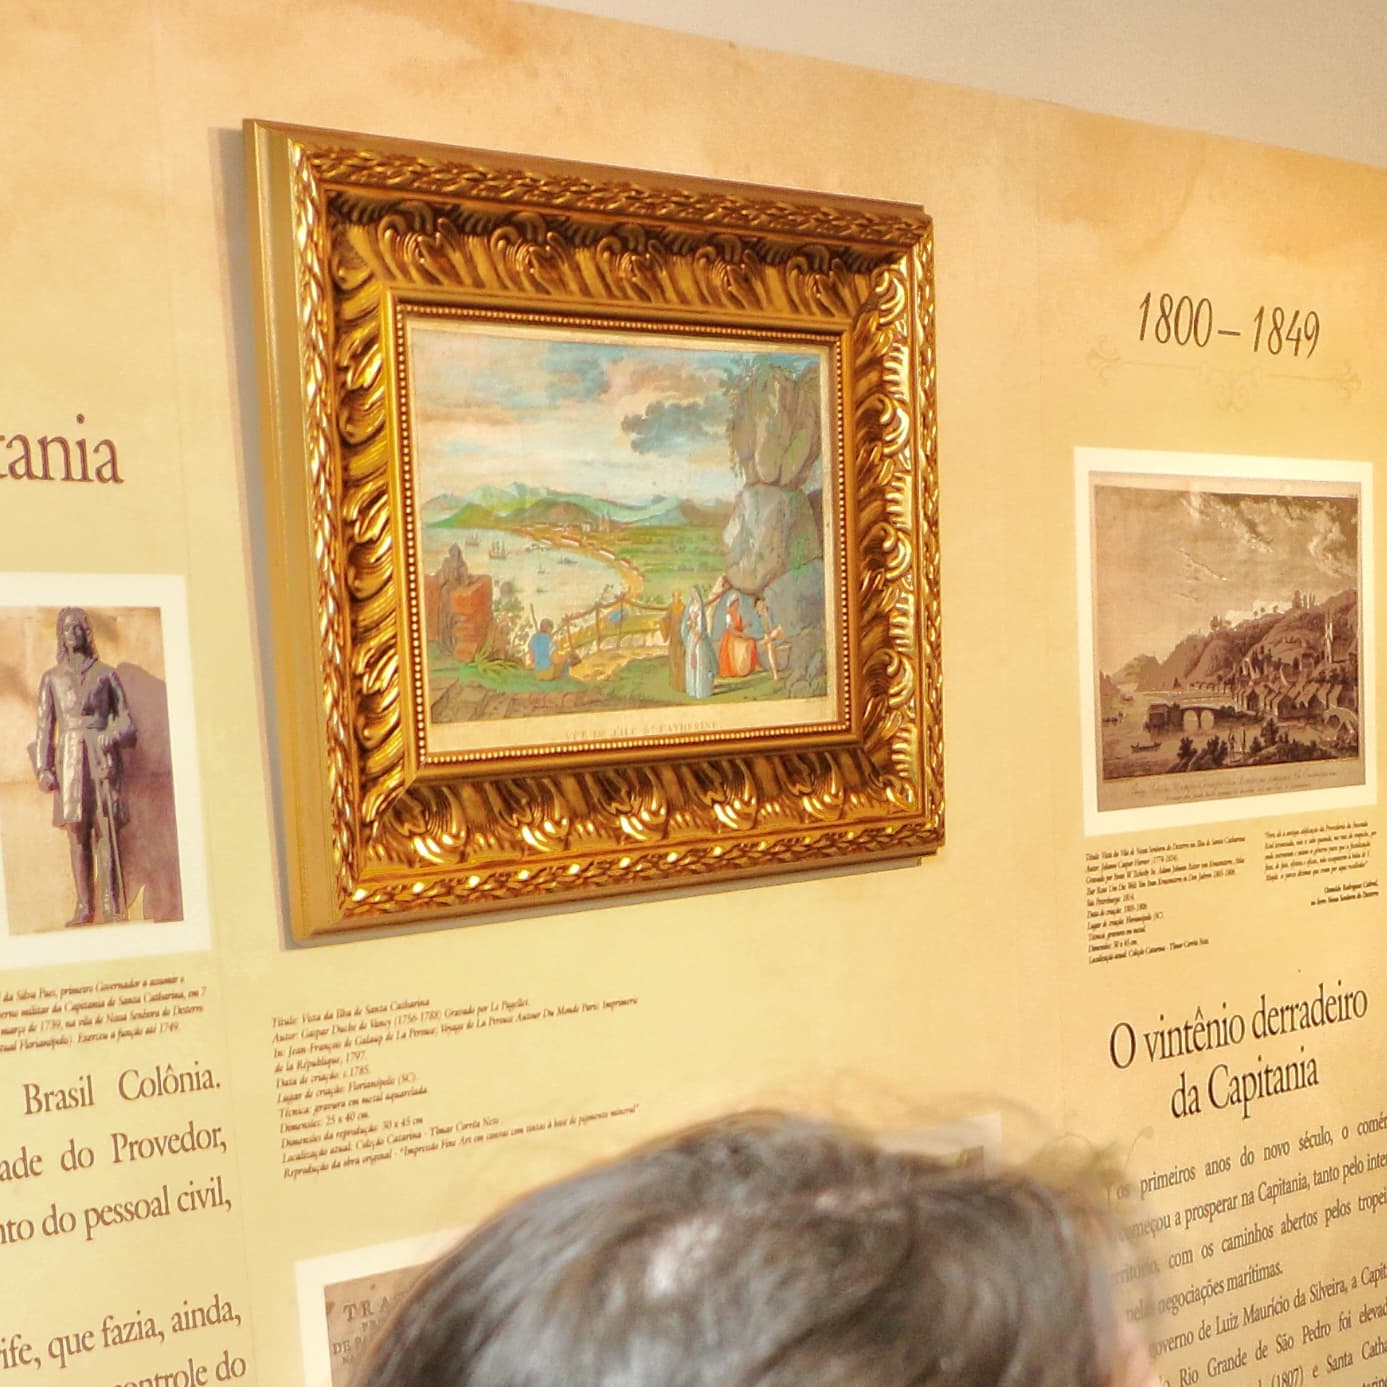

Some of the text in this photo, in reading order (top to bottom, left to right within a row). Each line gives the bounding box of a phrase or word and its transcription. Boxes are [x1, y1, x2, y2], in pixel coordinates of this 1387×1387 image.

[1110, 981, 1367, 1068] O vintênio derradeiro
[23, 1061, 220, 1114] Brasil Colônia.
[1171, 1047, 1319, 1118] da Capitania
[60, 1138, 94, 1171] do
[111, 1121, 226, 1163] Provedor,
[1140, 1166, 1196, 1201] primeiros
[1205, 1156, 1231, 1176] anos
[1240, 1145, 1254, 1167] do
[1263, 1141, 1290, 1160] novo
[1298, 1125, 1333, 1151] século,
[1341, 1126, 1348, 1139] o
[42, 1203, 76, 1236] do
[84, 1185, 170, 1240] pessoal
[177, 1176, 231, 1212] civil,
[1174, 1211, 1181, 1226] a
[1184, 1195, 1238, 1229] prosperar
[1241, 1190, 1254, 1207] na
[1258, 1172, 1310, 1204] Capitania,
[1313, 1166, 1339, 1186] tanto
[1342, 1155, 1364, 1184] pelo
[1167, 1249, 1193, 1269] com
[1201, 1242, 1214, 1259] os
[1221, 1223, 1273, 1252] caminhos
[1281, 1211, 1318, 1234] abertos
[1325, 1198, 1351, 1227] pelos
[1198, 1319, 1211, 1340] de
[1216, 1312, 1239, 1335] Luiz
[1242, 1296, 1290, 1326] Maurício
[1293, 1288, 1306, 1308] da
[1309, 1278, 1348, 1303] Silveira,
[1351, 1275, 1357, 1289] a
[1226, 1262, 1283, 1291] marítimas.
[48, 1331, 94, 1368] que
[101, 1310, 164, 1347] fazia,
[171, 1294, 241, 1332] ainda,
[215, 1350, 246, 1381] do
[1179, 1367, 1199, 1387] Rio
[1207, 1347, 1247, 1377] Grande
[1255, 1339, 1268, 1360] de
[1275, 1333, 1294, 1353] São
[1302, 1320, 1331, 1344] Pedro
[1338, 1310, 1351, 1331] foi
